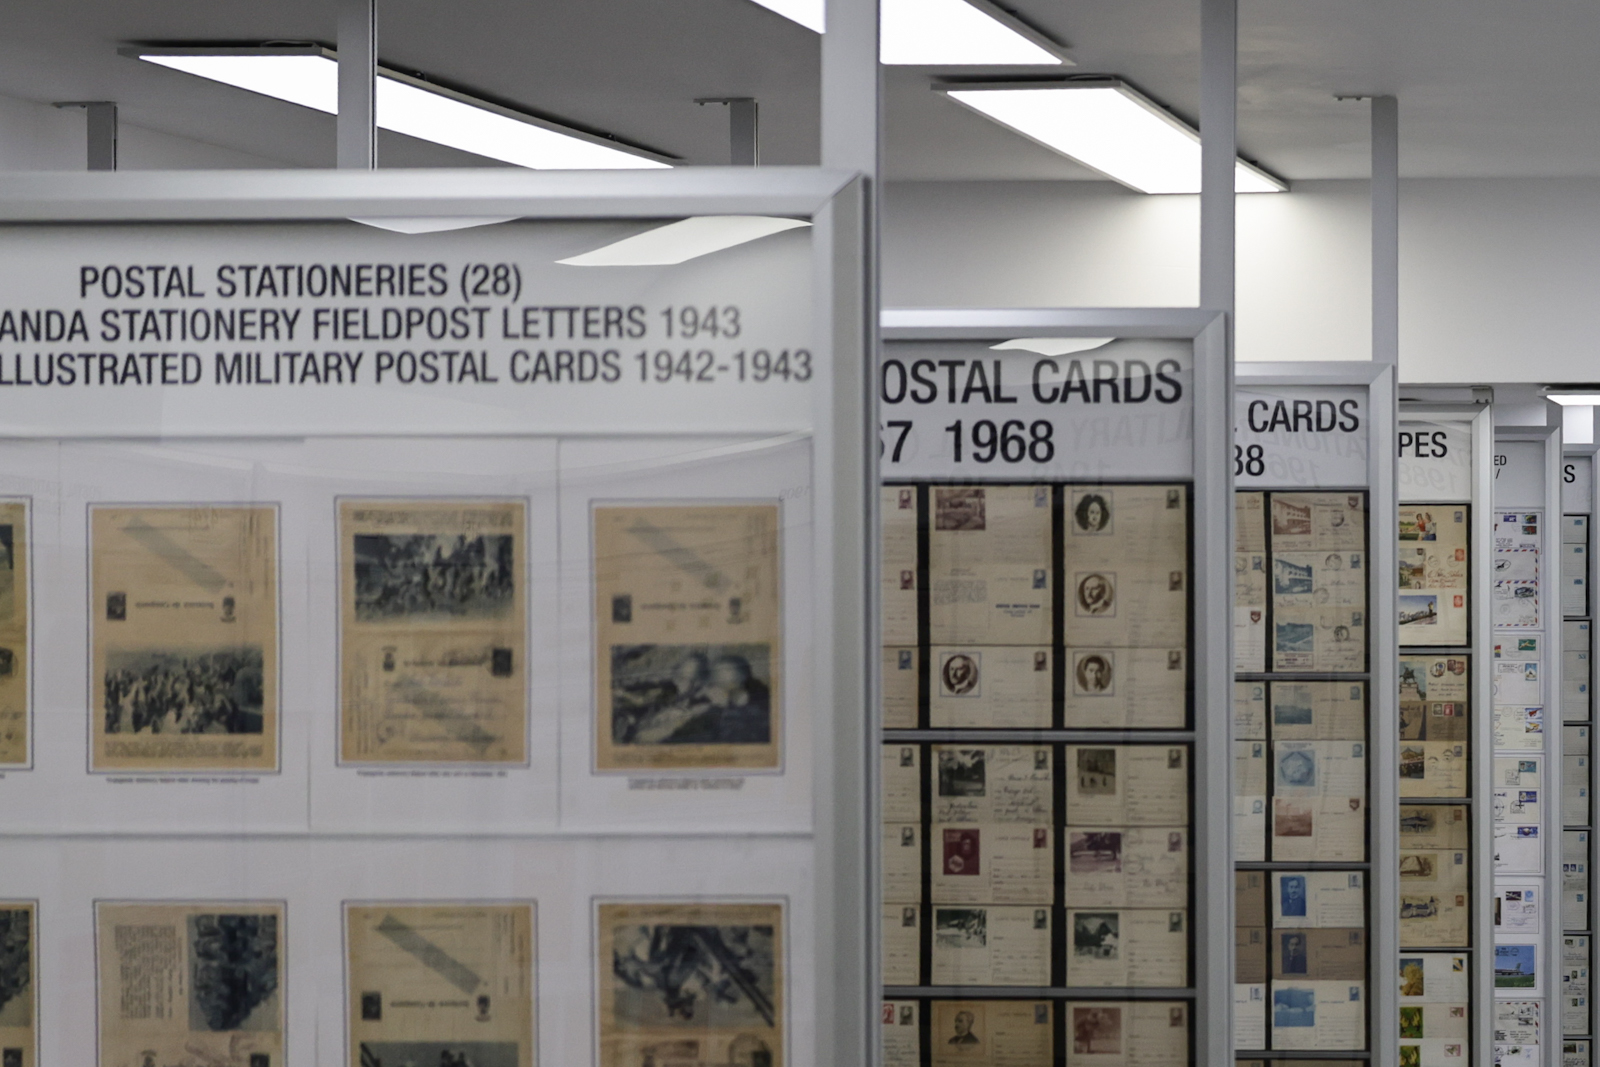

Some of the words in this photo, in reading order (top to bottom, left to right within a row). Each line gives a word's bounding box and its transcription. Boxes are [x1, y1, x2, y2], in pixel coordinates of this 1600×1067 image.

[80, 265, 205, 299] POSTAL
[216, 263, 448, 298] STATIONERIES
[460, 263, 522, 303] (28)
[0, 309, 90, 342] ANDA
[100, 308, 301, 342] STATIONERY
[313, 306, 491, 341] FIELDPOST
[502, 306, 647, 340] LETTERS
[660, 305, 742, 339] 1943
[215, 351, 364, 385] MILITARY
[375, 350, 498, 385] POSTAL
[509, 349, 621, 384] CARDS
[636, 348, 814, 383] 1942-1943
[880, 358, 1018, 405] OSTAL
[1031, 358, 1183, 405] CARDS
[1247, 399, 1360, 433] CARDS
[945, 419, 1055, 464] 1968
[1398, 431, 1448, 459] PES
